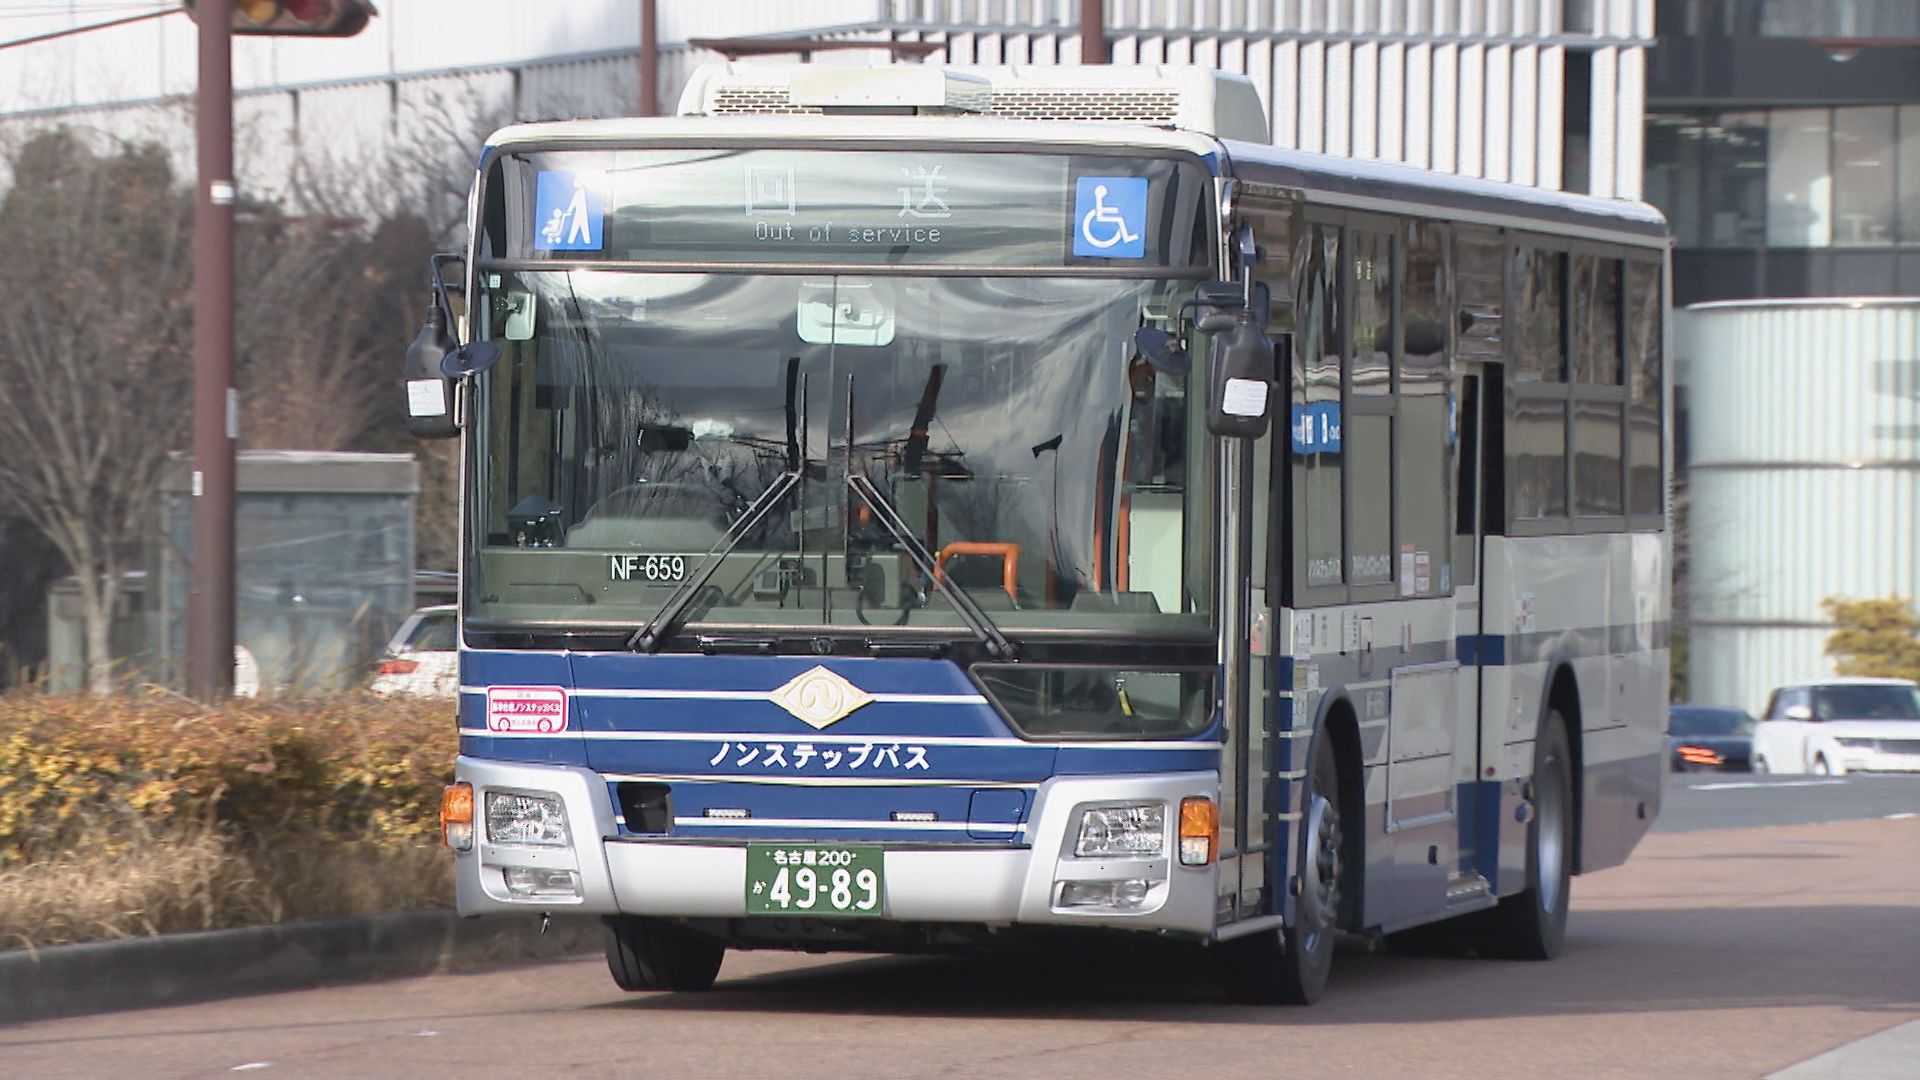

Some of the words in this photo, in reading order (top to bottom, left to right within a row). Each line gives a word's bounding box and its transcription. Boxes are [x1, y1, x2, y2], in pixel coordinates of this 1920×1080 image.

[754, 221, 795, 240] Out
[809, 221, 833, 242] of
[848, 223, 942, 243] service
[611, 556, 685, 580] NF-659
[710, 743, 930, 770] ノンステップバス
[752, 880, 766, 895] か
[769, 867, 878, 911] 49-89
